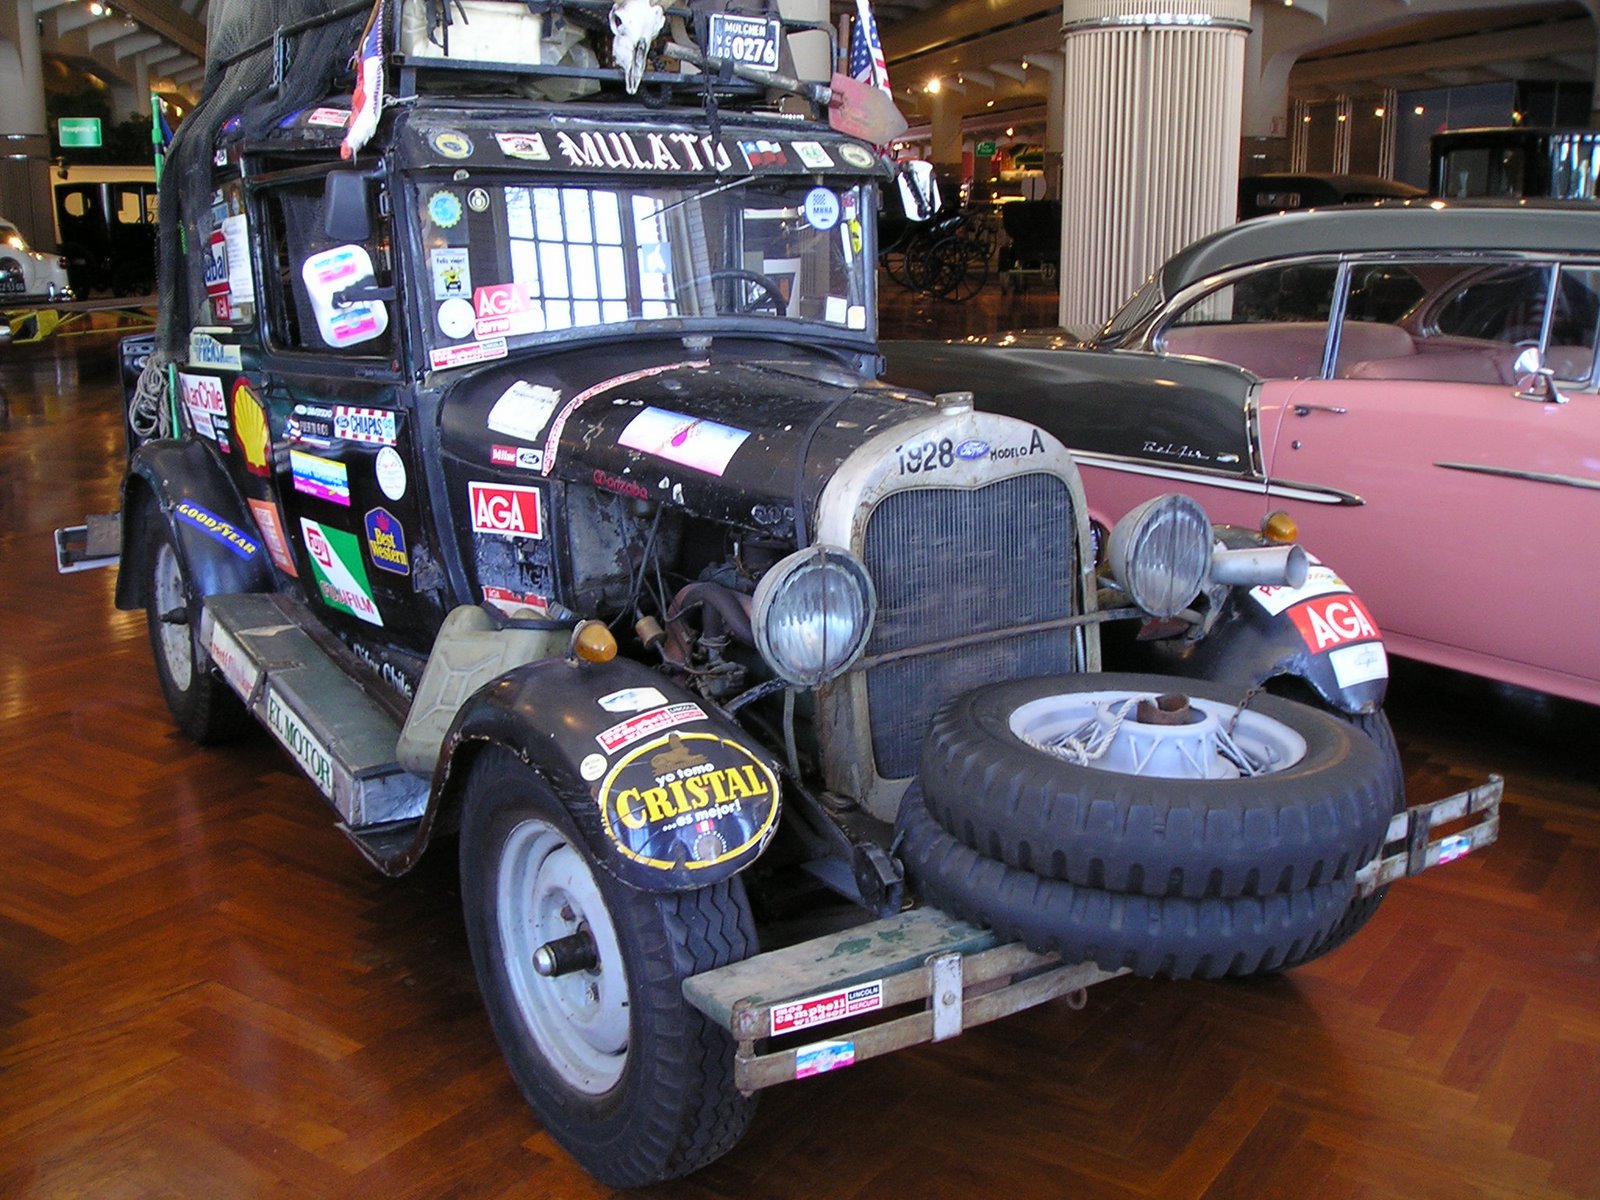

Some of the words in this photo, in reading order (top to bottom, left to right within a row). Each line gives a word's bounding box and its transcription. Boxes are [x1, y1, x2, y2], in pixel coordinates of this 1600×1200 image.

[724, 22, 766, 37] MULCHEN
[732, 36, 776, 64] 0276
[557, 131, 732, 172] MULATO
[479, 284, 524, 318] AGA
[350, 414, 383, 437] CHIAPAS
[895, 437, 955, 475] 1928
[959, 440, 989, 457] Ford
[990, 446, 1028, 460] MODELO
[1029, 428, 1046, 455] A
[476, 488, 526, 532] AGA
[177, 503, 256, 554] GOODYEAR
[373, 526, 397, 549] Best
[369, 539, 408, 566] Western
[1306, 597, 1376, 649] AGA
[269, 697, 284, 734] EL
[284, 714, 332, 789] MOTOR
[655, 773, 675, 788] yo
[679, 762, 715, 781] tomo
[616, 764, 769, 830] CRISTAL
[694, 798, 742, 824] mejor!
[848, 997, 880, 1011] MERCURY
[849, 986, 879, 1000] LINCOLN
[775, 1003, 804, 1017] moe
[775, 998, 846, 1024] campbell
[793, 1008, 846, 1027] windsor
